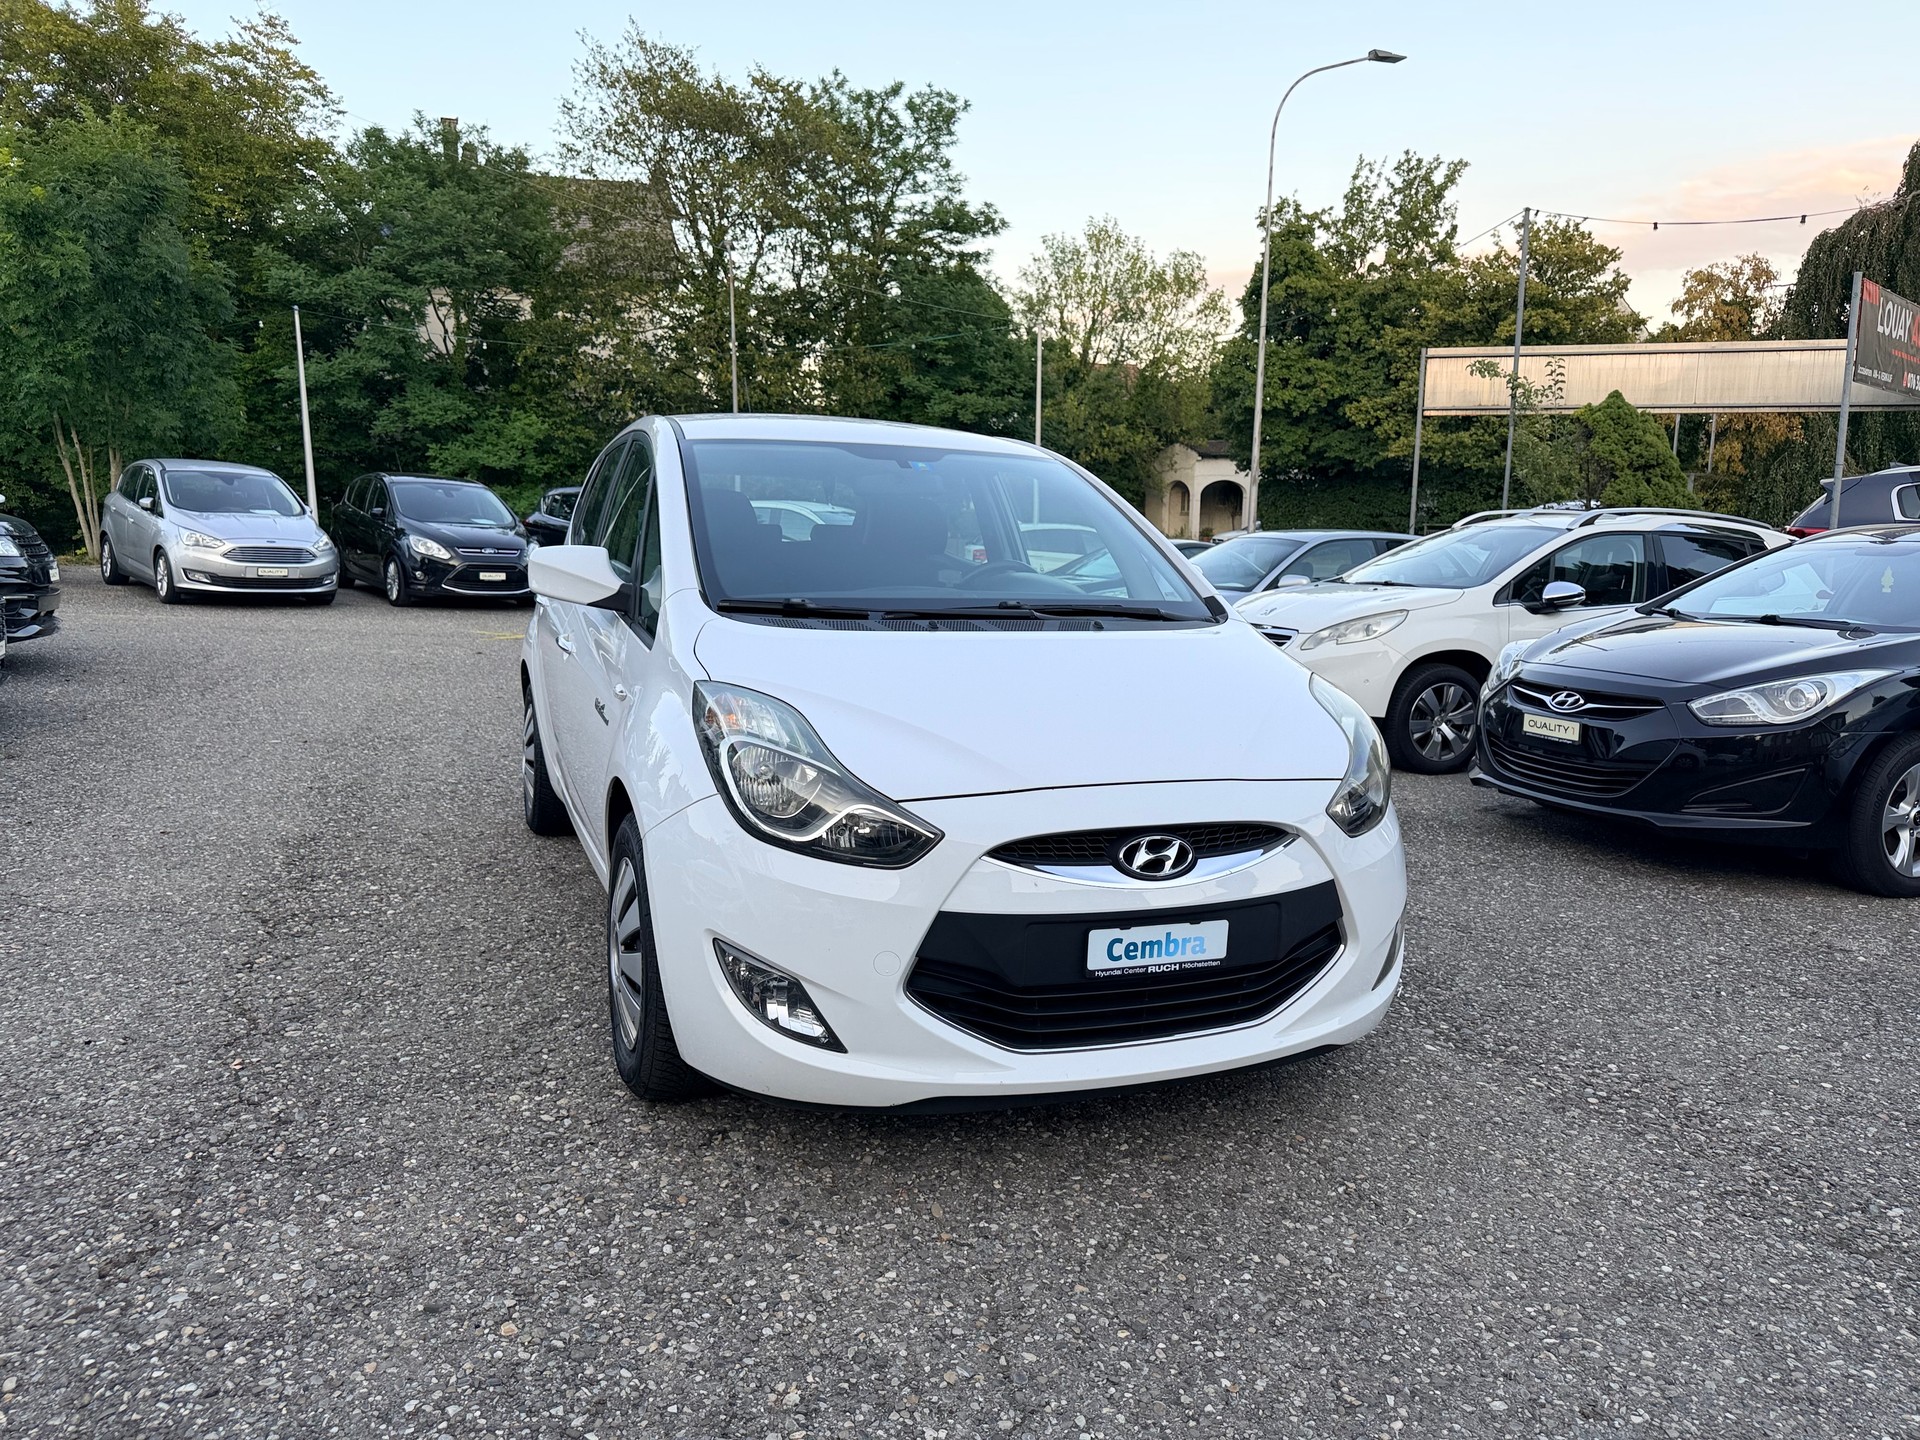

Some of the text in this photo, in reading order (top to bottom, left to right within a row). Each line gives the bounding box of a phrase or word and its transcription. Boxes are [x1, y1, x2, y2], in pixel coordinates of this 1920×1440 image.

[1877, 297, 1913, 343] LOUAY
[1106, 931, 1207, 962] Cembra
[1095, 960, 1221, 978] Hyundai Center RUCH Höchstetten
